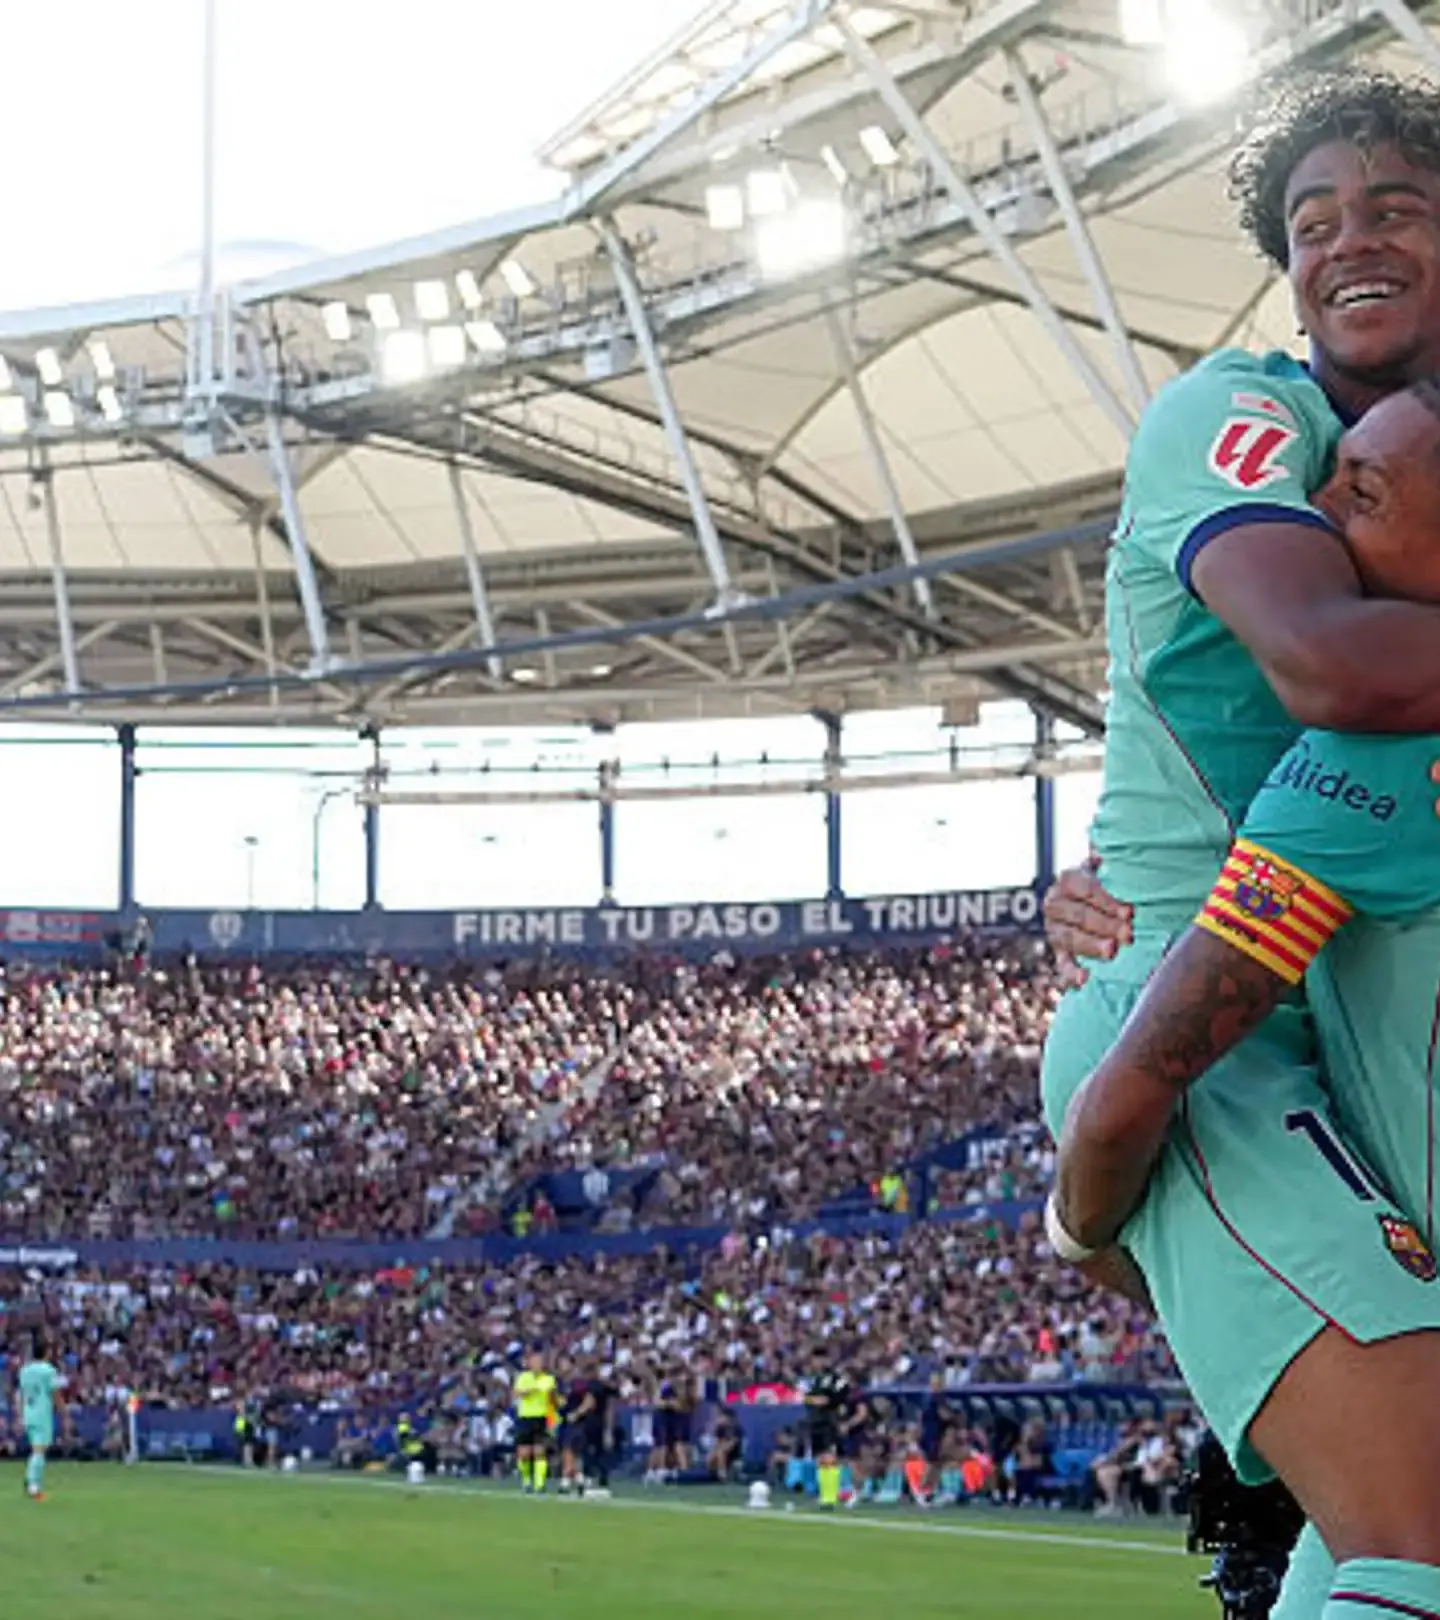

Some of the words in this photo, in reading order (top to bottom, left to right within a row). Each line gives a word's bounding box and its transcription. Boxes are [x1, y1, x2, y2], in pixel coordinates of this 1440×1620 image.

[454, 911, 584, 944] FIRME
[600, 909, 653, 941] TU
[668, 904, 780, 939] PASO
[802, 901, 852, 932] EL
[864, 889, 1037, 931] TRIUNFO
